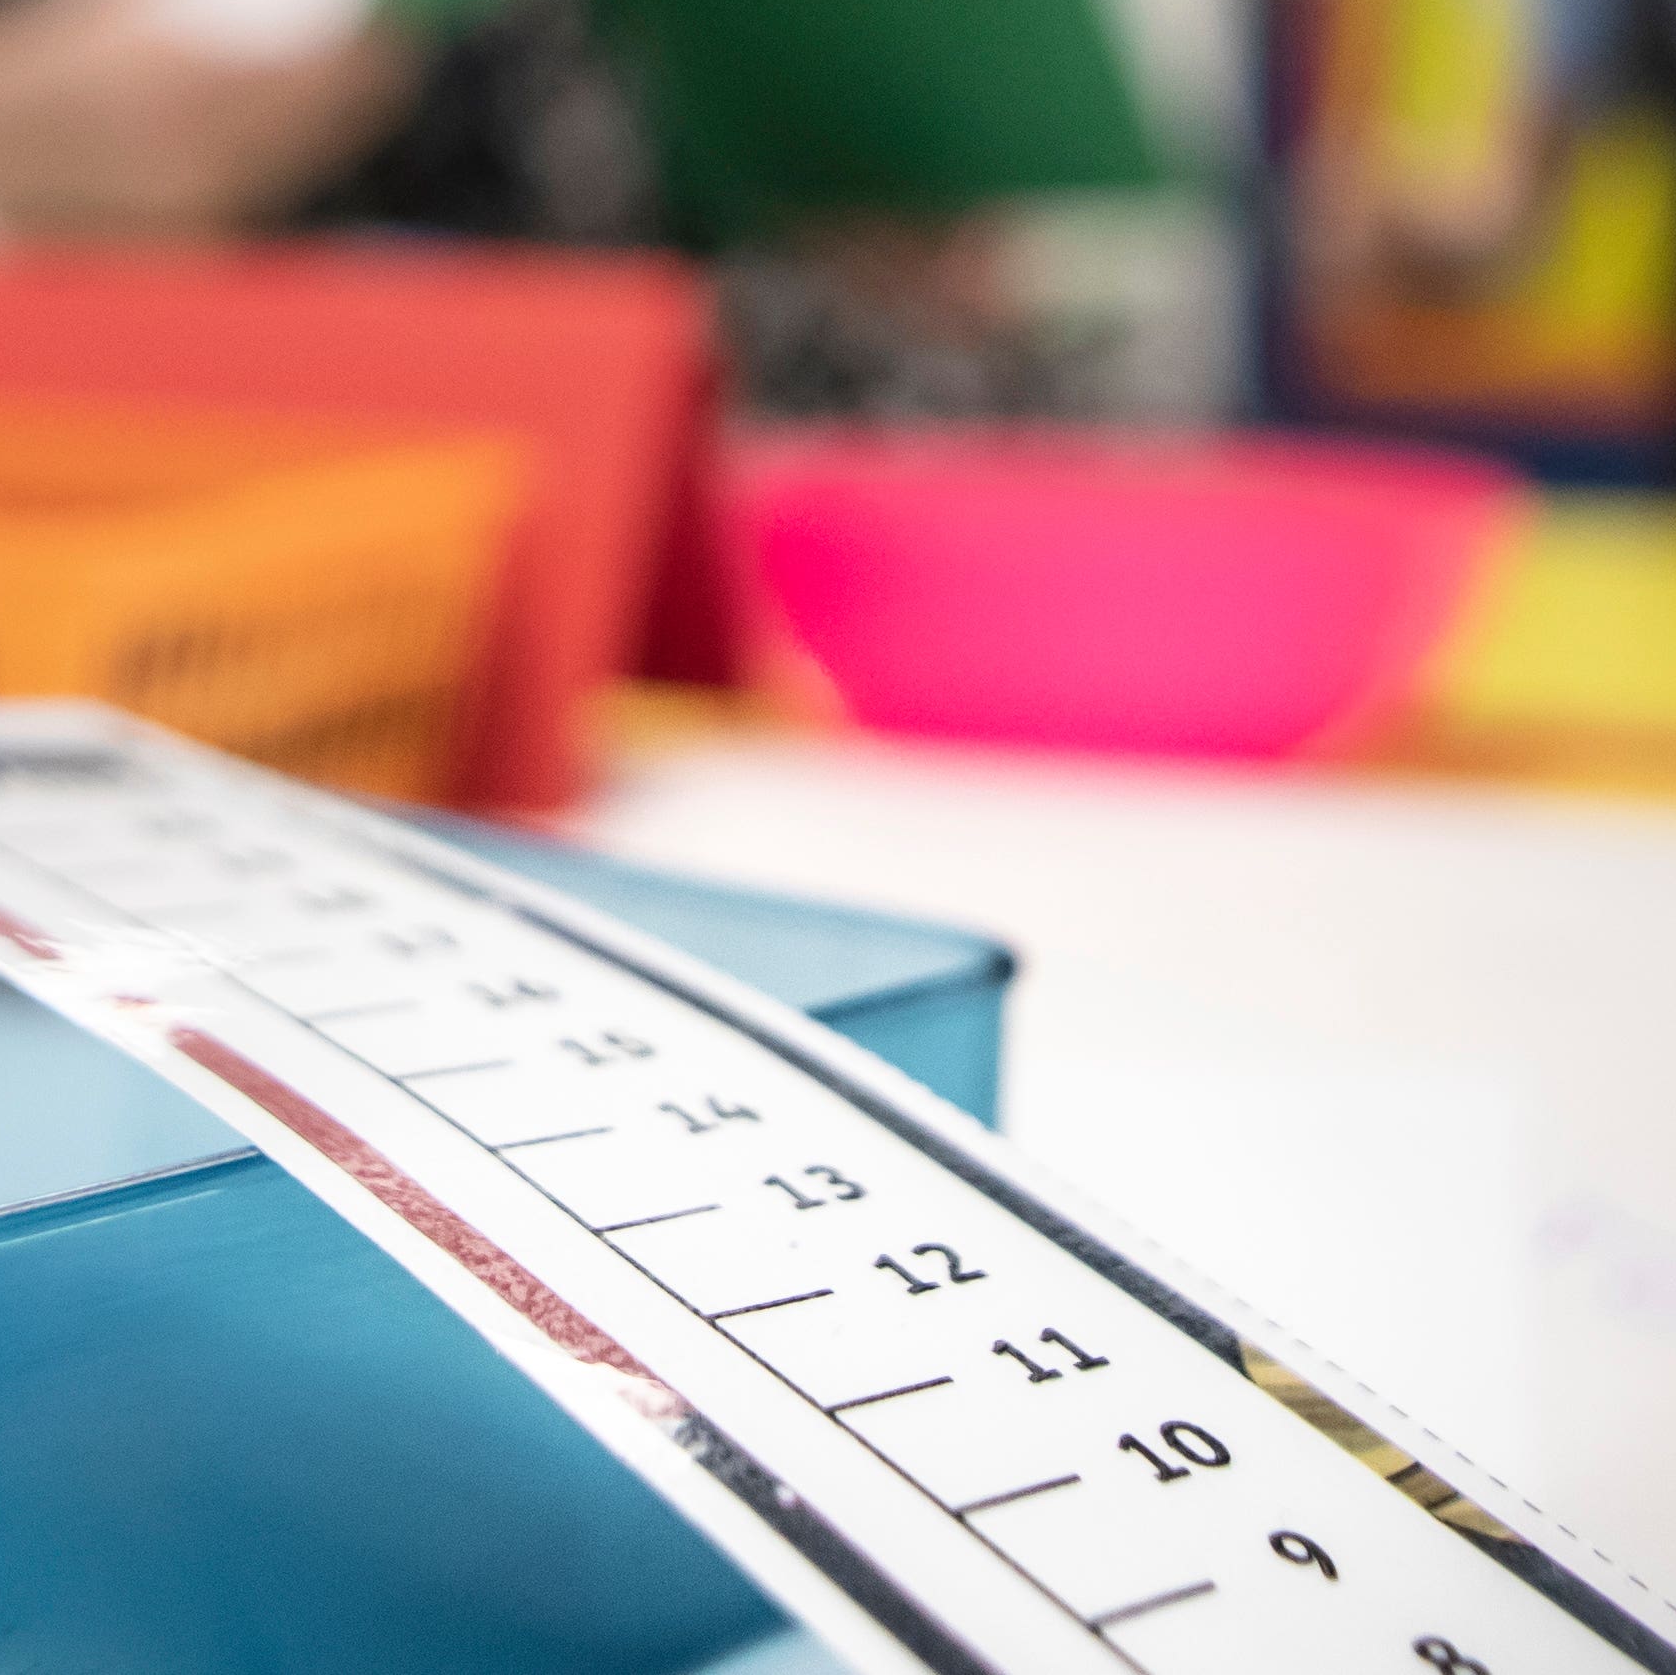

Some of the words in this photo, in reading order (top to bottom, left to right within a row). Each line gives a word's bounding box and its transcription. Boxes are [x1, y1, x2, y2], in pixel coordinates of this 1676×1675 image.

[558, 1031, 657, 1068] 15
[657, 1096, 762, 1136] 14
[763, 1165, 867, 1211] 13
[873, 1243, 987, 1296] 12
[991, 1327, 1110, 1385] 11
[1117, 1420, 1232, 1484] 10
[1268, 1530, 1339, 1582] 9
[1412, 1636, 1492, 1675] 8
